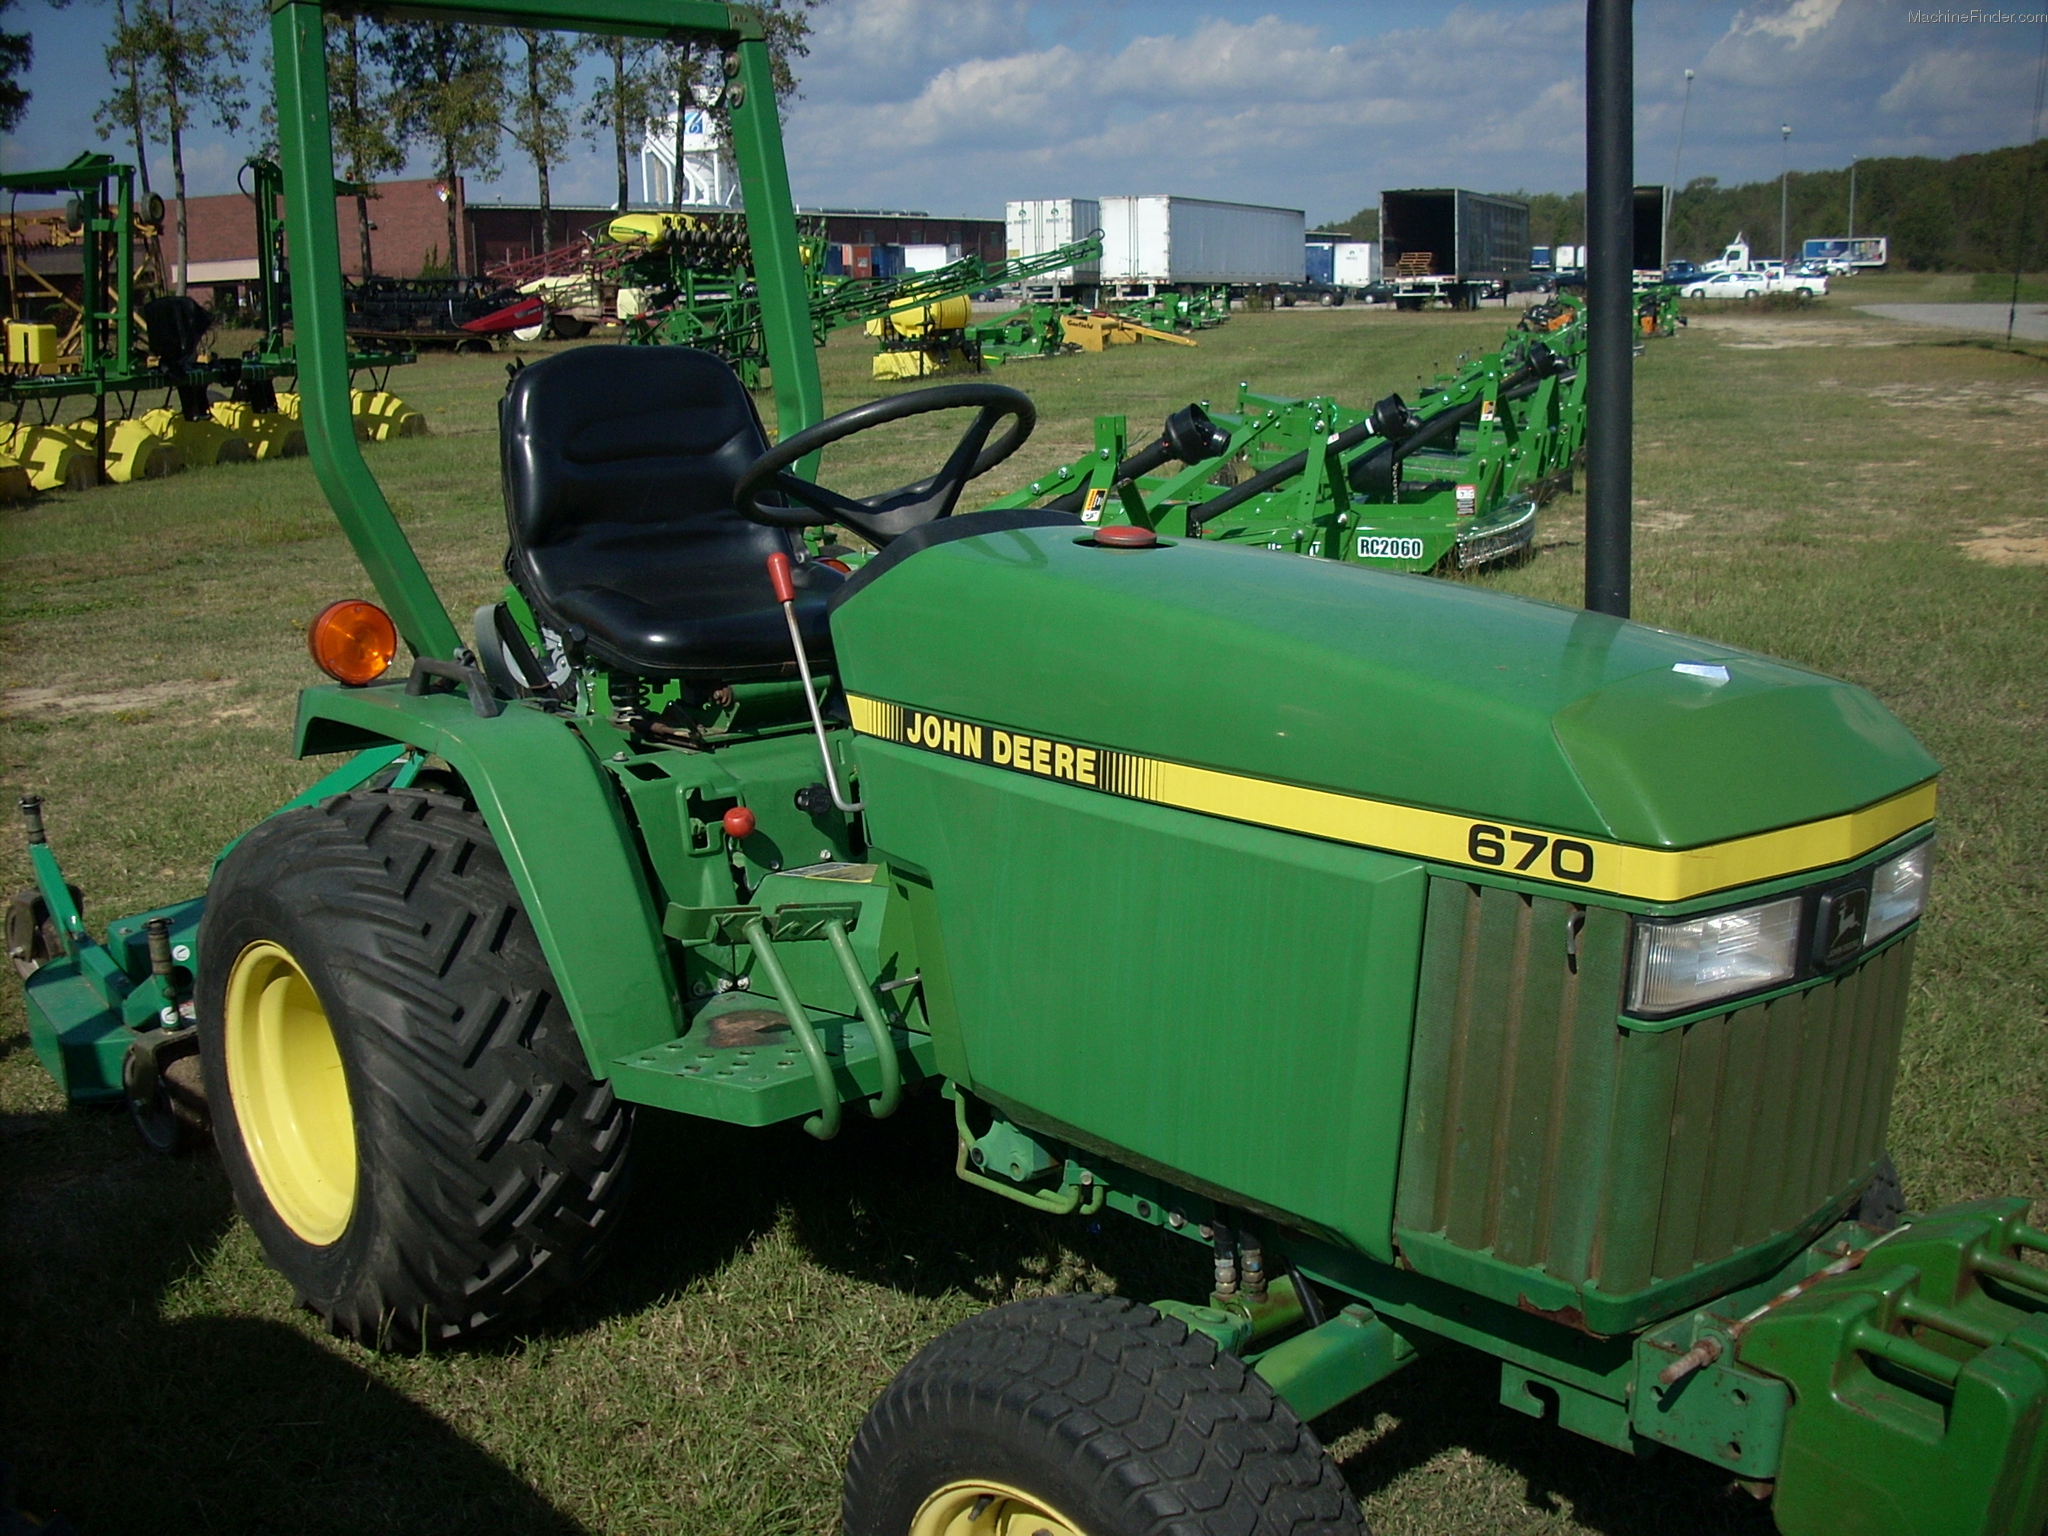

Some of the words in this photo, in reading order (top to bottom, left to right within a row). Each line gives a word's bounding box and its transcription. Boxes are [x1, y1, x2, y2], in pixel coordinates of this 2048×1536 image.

[1359, 537, 1423, 558] RC2060
[907, 712, 983, 759] JOHN
[992, 730, 1097, 786] DEERE
[1467, 823, 1594, 883] 670
